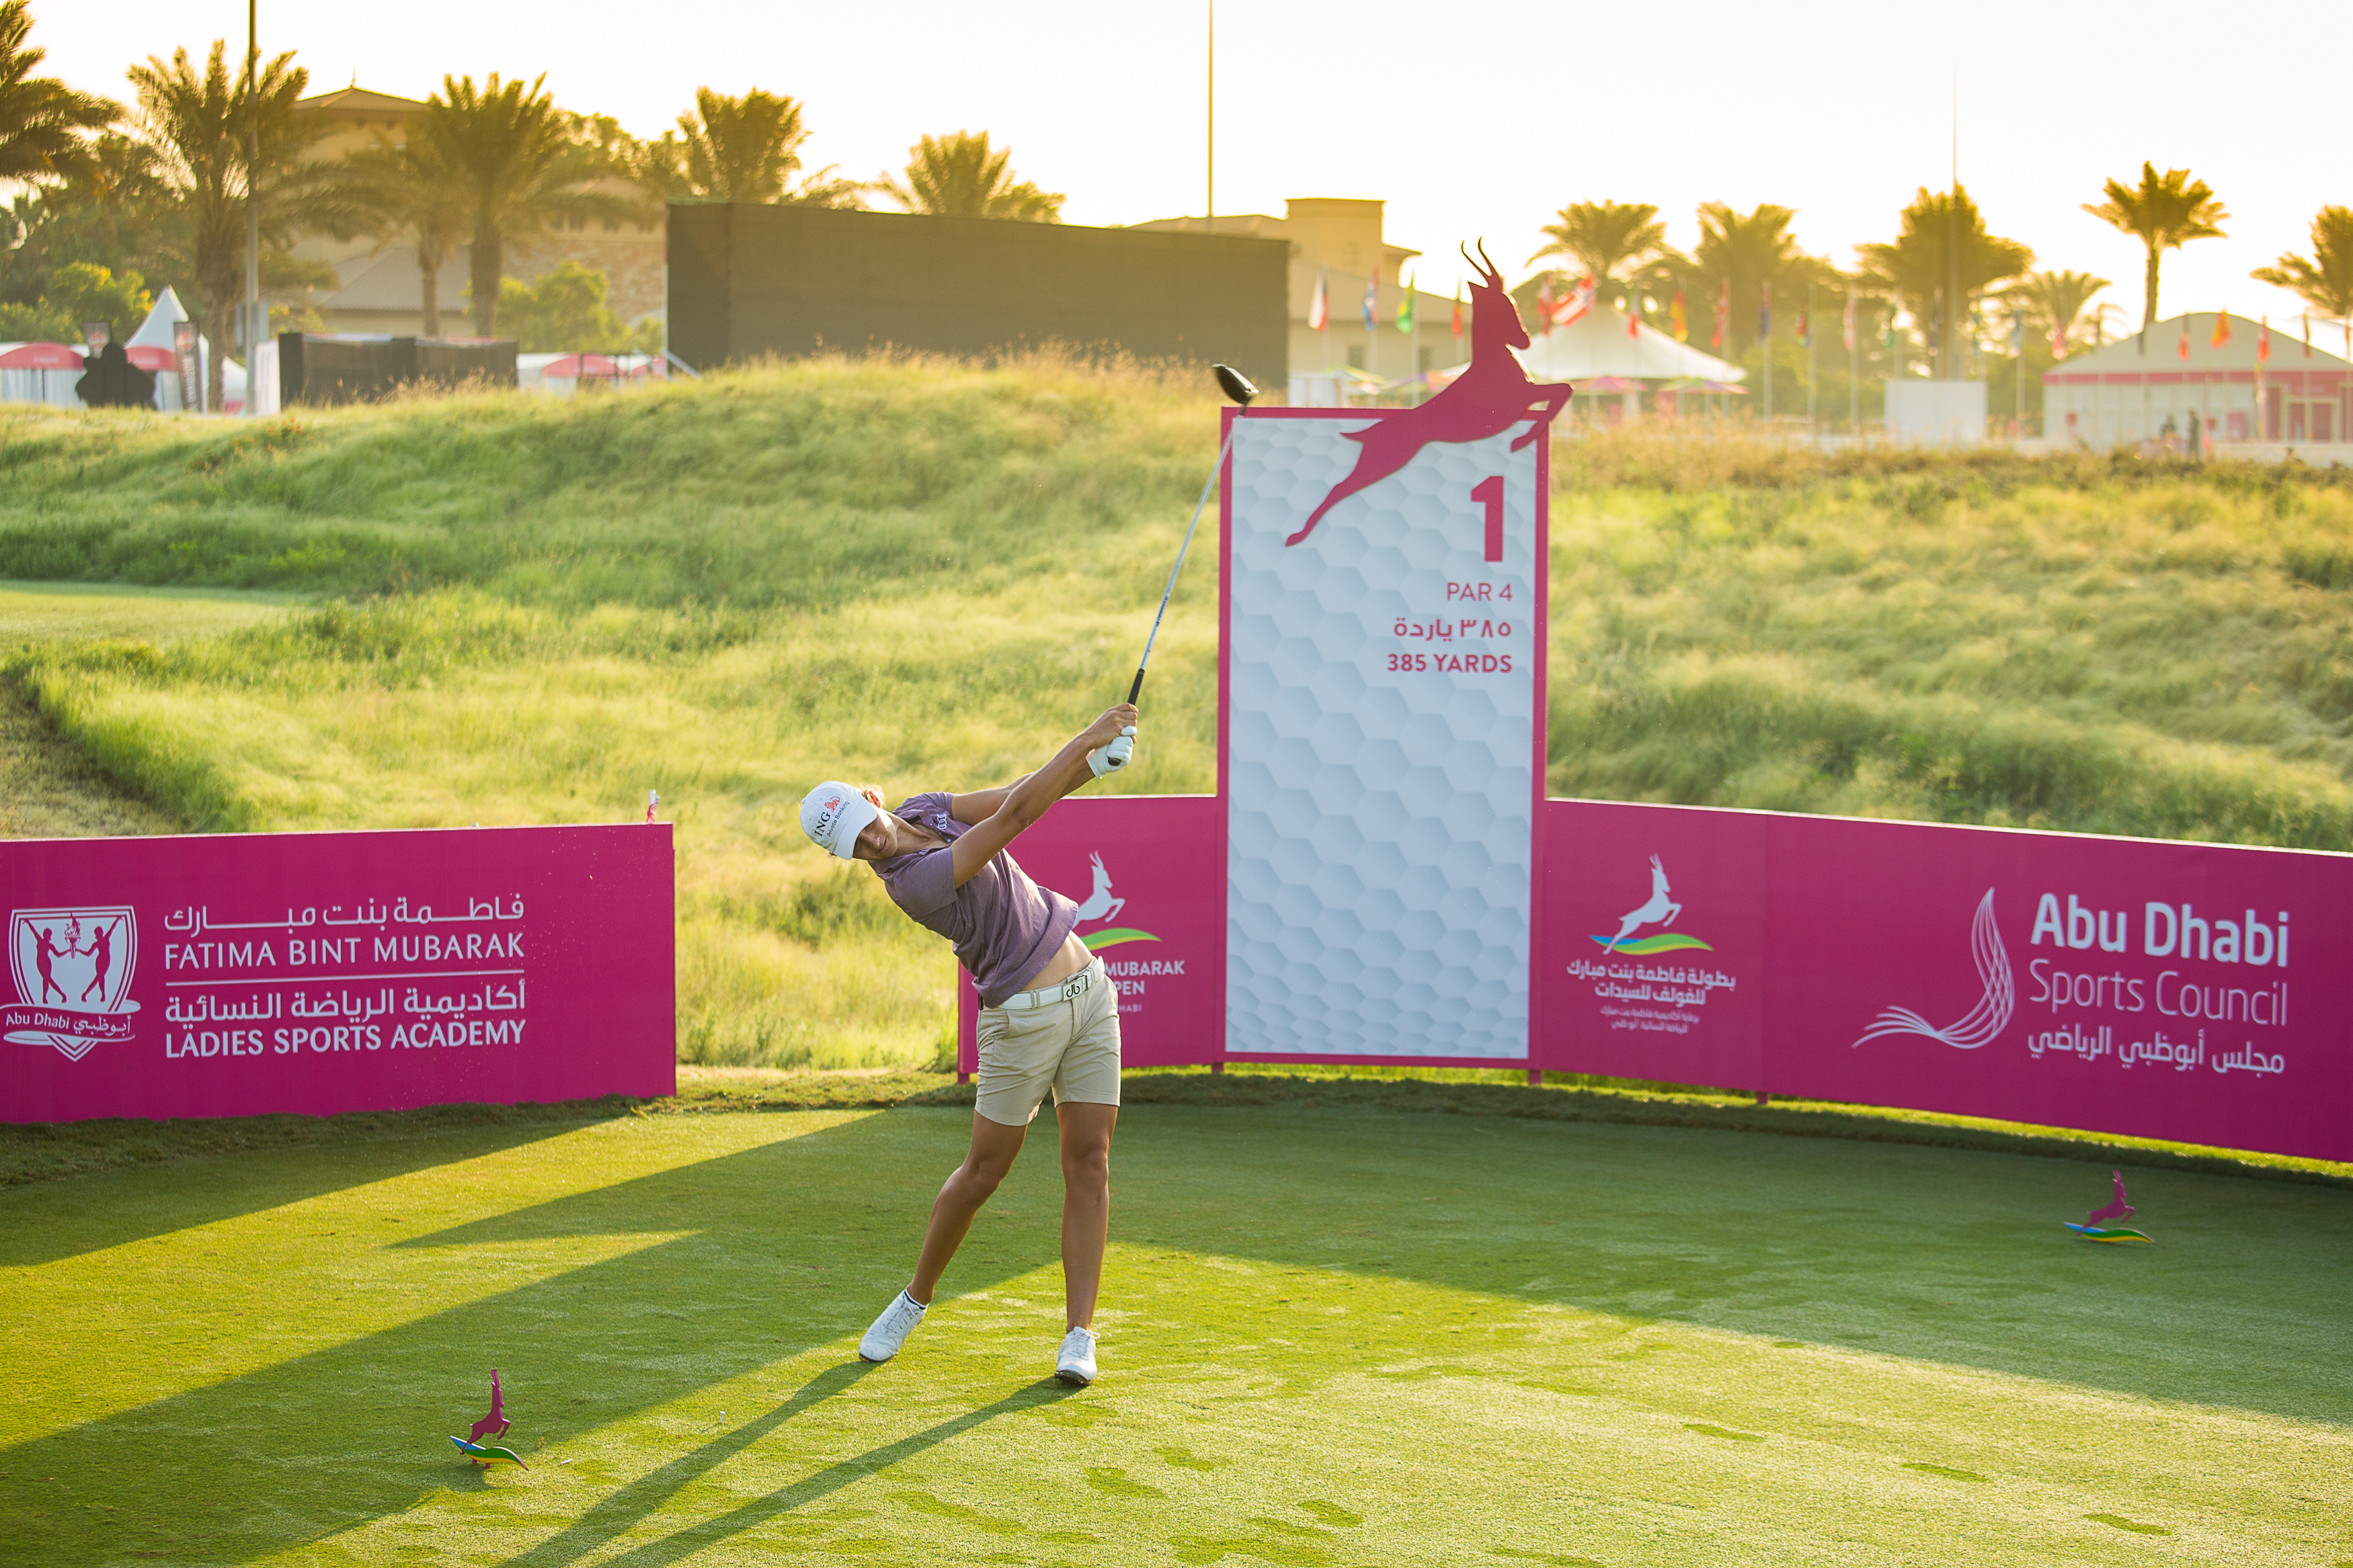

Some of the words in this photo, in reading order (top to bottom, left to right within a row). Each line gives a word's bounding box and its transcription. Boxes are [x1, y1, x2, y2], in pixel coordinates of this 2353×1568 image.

[1470, 476, 1504, 562] 1
[1446, 582, 1492, 602] PAR
[1499, 583, 1513, 602] 4
[1394, 617, 1453, 642] ياردة
[1460, 619, 1512, 638] ٣٨٥
[1387, 653, 1427, 672] 385
[1433, 654, 1513, 673] YARDS
[814, 811, 830, 837] ING
[827, 819, 838, 837] Private
[834, 800, 850, 819] Banking
[164, 905, 316, 938] مبارك
[323, 897, 387, 931] بنت
[393, 893, 524, 924] فاطمة
[2030, 893, 2126, 953] Abu
[2145, 901, 2289, 967] Dhabi
[165, 941, 276, 970] FATIMA
[289, 938, 361, 965] BINT
[374, 932, 524, 962] MUBARAK
[1105, 960, 1185, 977] MUBARAK
[1566, 960, 1606, 980] مبارك
[1607, 963, 1634, 983] بنت
[1636, 963, 1686, 984] فاطمة
[1687, 967, 1737, 991] بطولة
[403, 978, 526, 1020] أكاديمية
[1113, 980, 1145, 995] PEN
[1595, 981, 1650, 1003] للسيدات
[1652, 985, 1706, 1007] للغولف
[2029, 958, 2145, 1014] Sports
[2156, 971, 2287, 1026] Council
[165, 992, 281, 1030] النسائية
[291, 989, 394, 1023] الرياضة
[1118, 1003, 1142, 1013] HABI
[6, 1011, 30, 1026] Abu
[34, 1012, 70, 1029] Dhabi
[166, 1029, 264, 1059] LADIES
[274, 1025, 381, 1055] SPORTS
[391, 1019, 526, 1049] ACADEMY
[2028, 1023, 2112, 1061] الرياضي
[2212, 1040, 2284, 1078] مجلس
